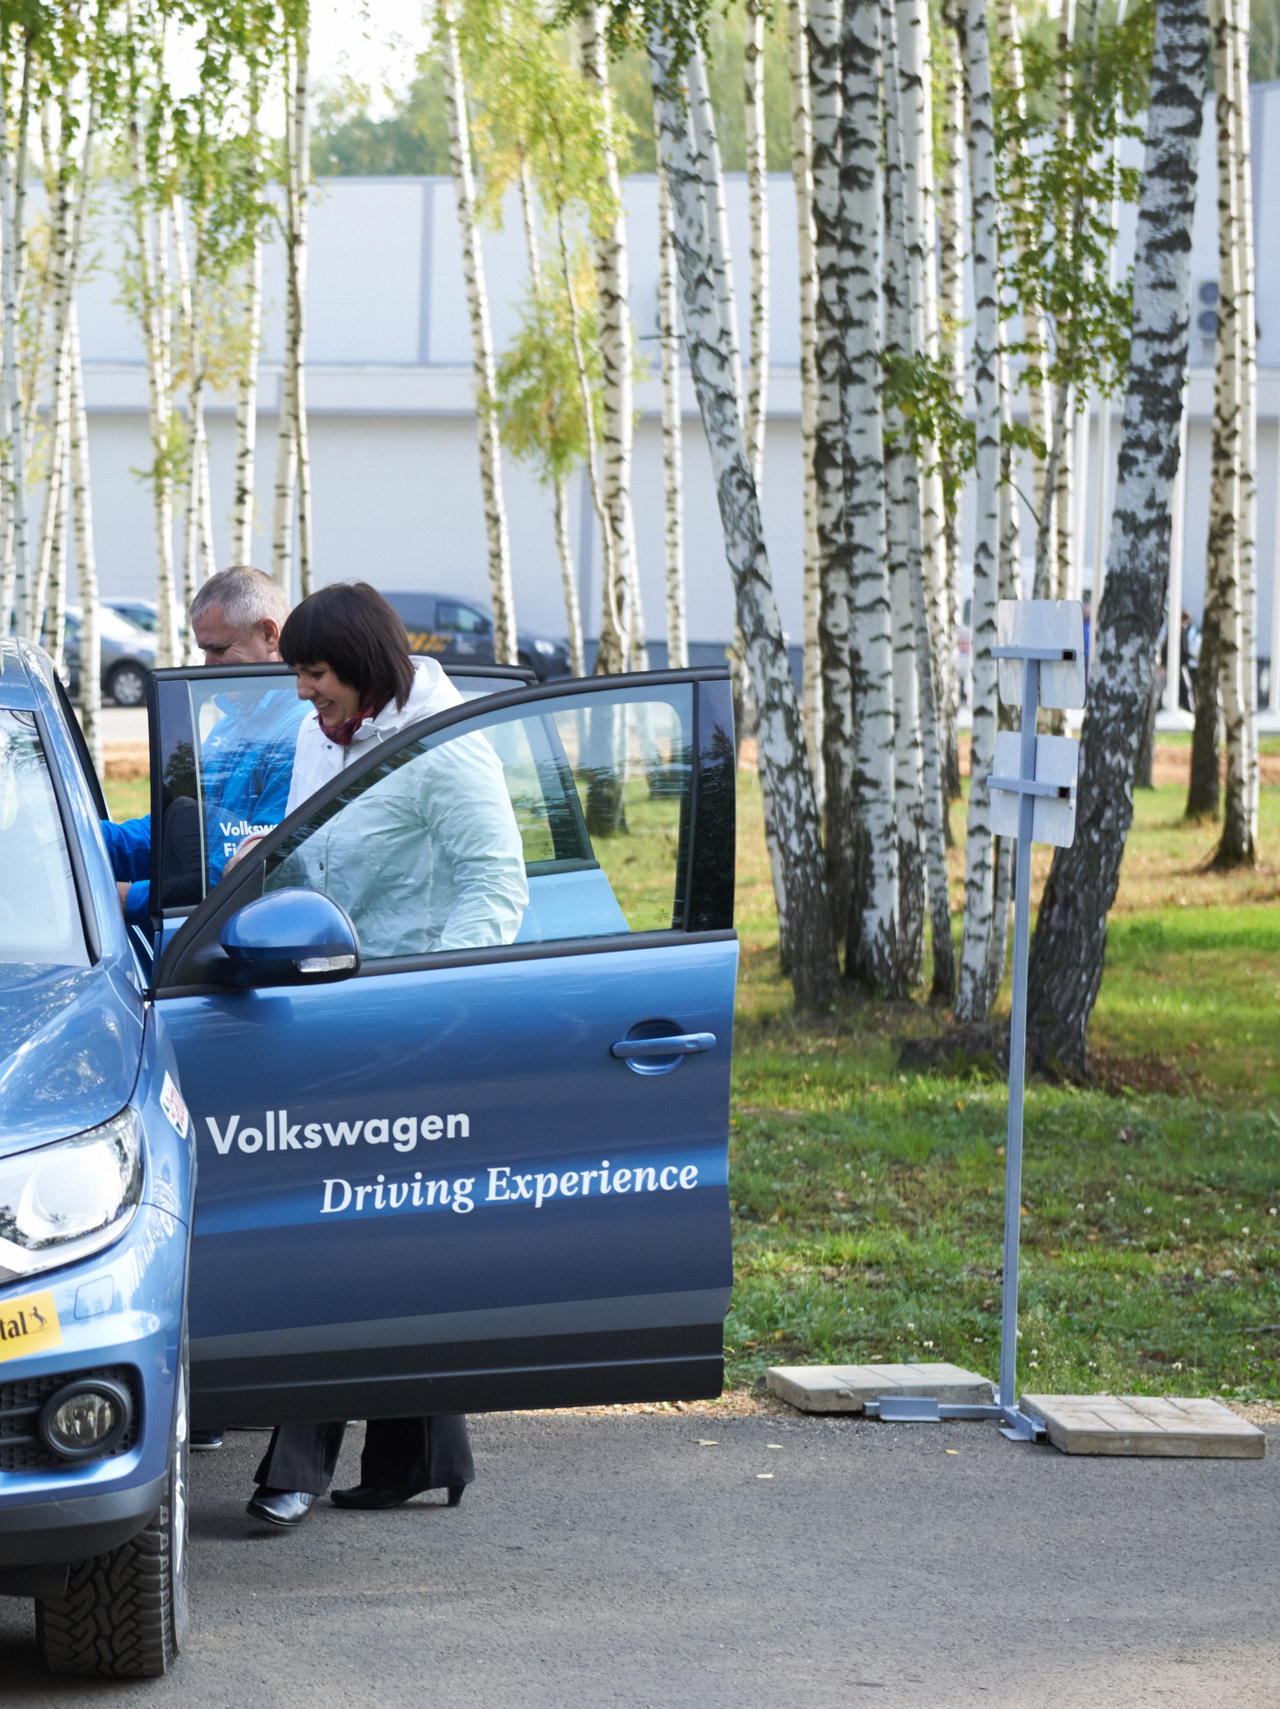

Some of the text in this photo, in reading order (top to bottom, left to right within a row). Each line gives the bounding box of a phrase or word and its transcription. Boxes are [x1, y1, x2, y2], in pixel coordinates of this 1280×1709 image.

[205, 1109, 471, 1155] Volkswagen
[320, 1160, 699, 1214] Driving Experience
